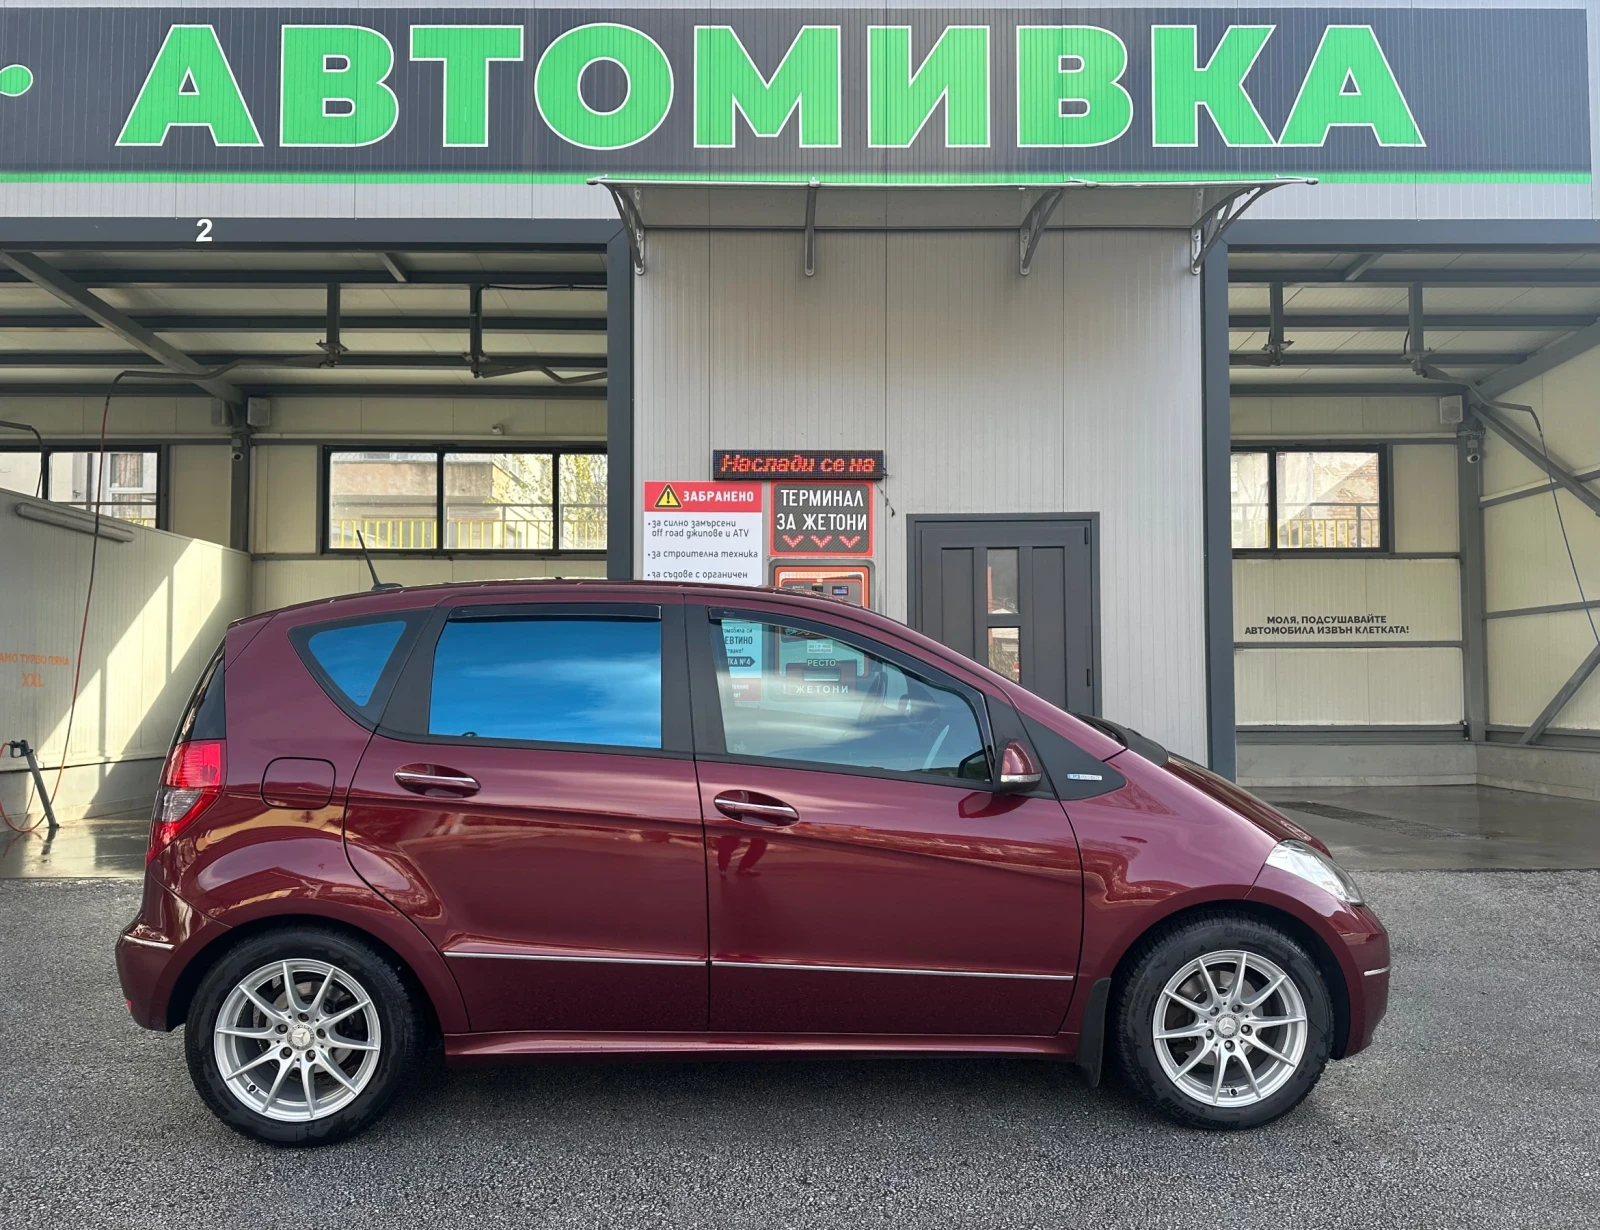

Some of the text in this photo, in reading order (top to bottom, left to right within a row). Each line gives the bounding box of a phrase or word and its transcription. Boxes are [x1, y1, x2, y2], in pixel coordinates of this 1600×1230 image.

[114, 22, 1427, 151] АВТОМИВКА
[195, 218, 214, 243] 2
[820, 458, 845, 472] се
[849, 458, 875, 472] на
[683, 490, 754, 502] ЗАБРАНЕНО
[780, 489, 864, 507] ТЕРМИНАЛ
[652, 520, 661, 529] за
[691, 520, 737, 529] замърсени
[776, 513, 867, 531] ЗА ЖЕТОНИ
[652, 529, 663, 537] off
[665, 529, 684, 537] road
[686, 529, 723, 539] джипове
[732, 529, 749, 537] ATV
[652, 550, 758, 560] за строителна техника
[663, 569, 693, 579] съдове
[702, 571, 748, 580] органичен
[1266, 614, 1387, 625] МОЛЯ, ПОДСУШАВАЙТЕ
[1244, 626, 1410, 635] АВТОМОБИЛА ИЗВЪН КЛЕТКАТА!
[0, 653, 18, 663] АМО
[807, 659, 836, 667] РЕСТО
[22, 673, 44, 687] XXL
[795, 685, 849, 694] ЖЕТОНИ
